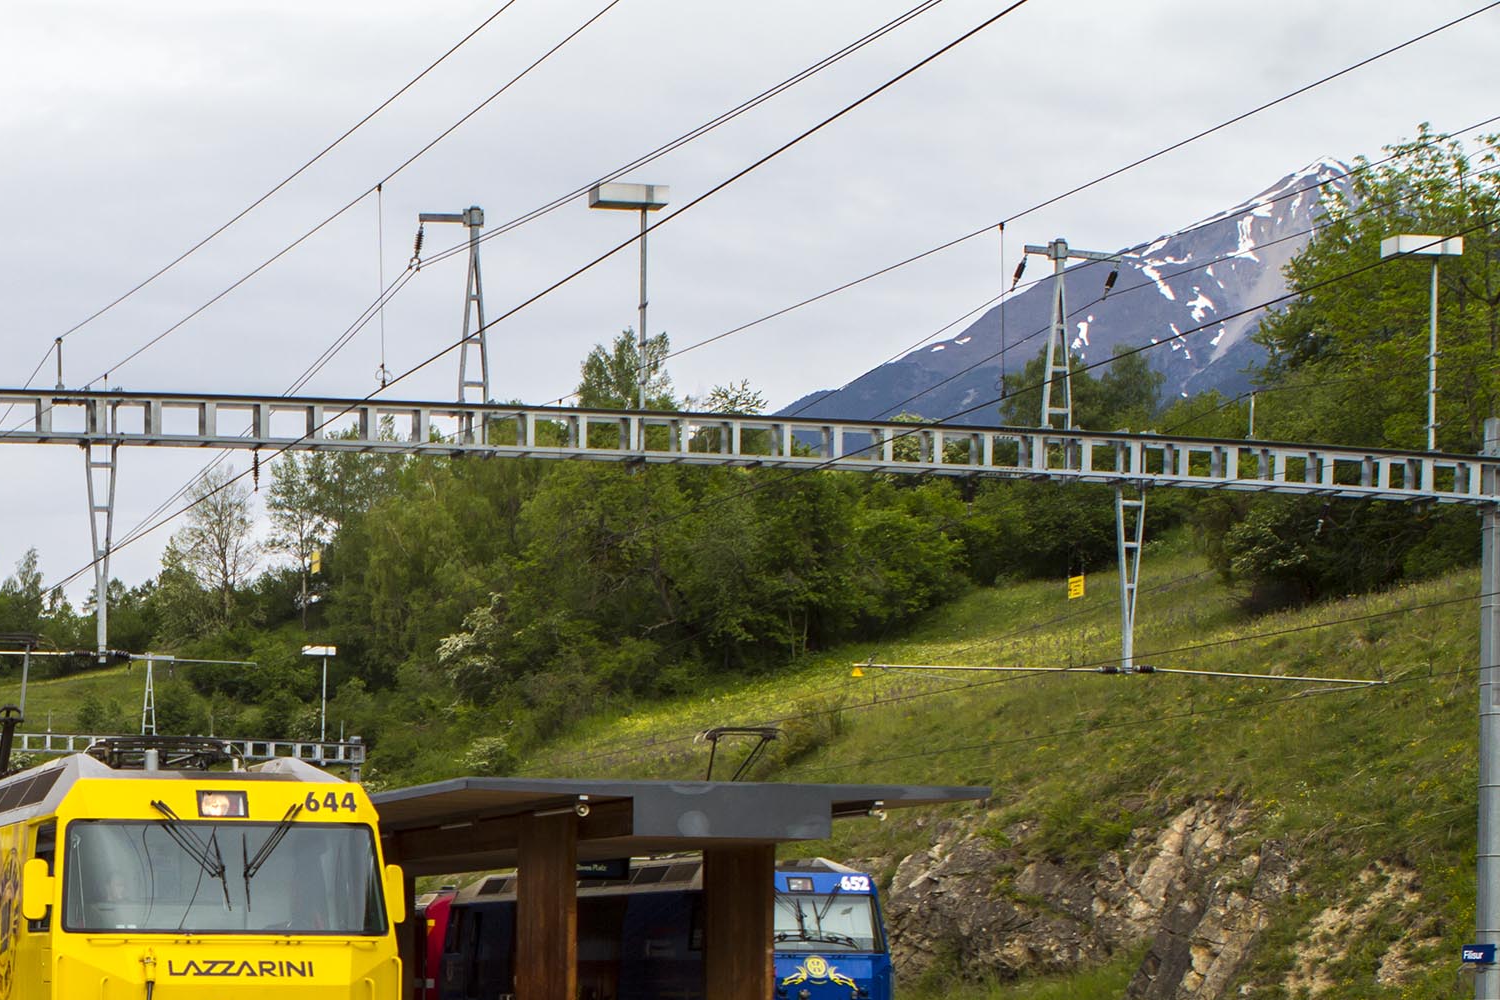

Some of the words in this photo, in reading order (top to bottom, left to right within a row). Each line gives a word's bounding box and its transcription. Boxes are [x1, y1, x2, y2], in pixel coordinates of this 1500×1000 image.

[305, 791, 358, 813] 644
[840, 876, 870, 891] 652
[1463, 950, 1485, 960] Filisur
[168, 960, 315, 978] LAZZARINI
